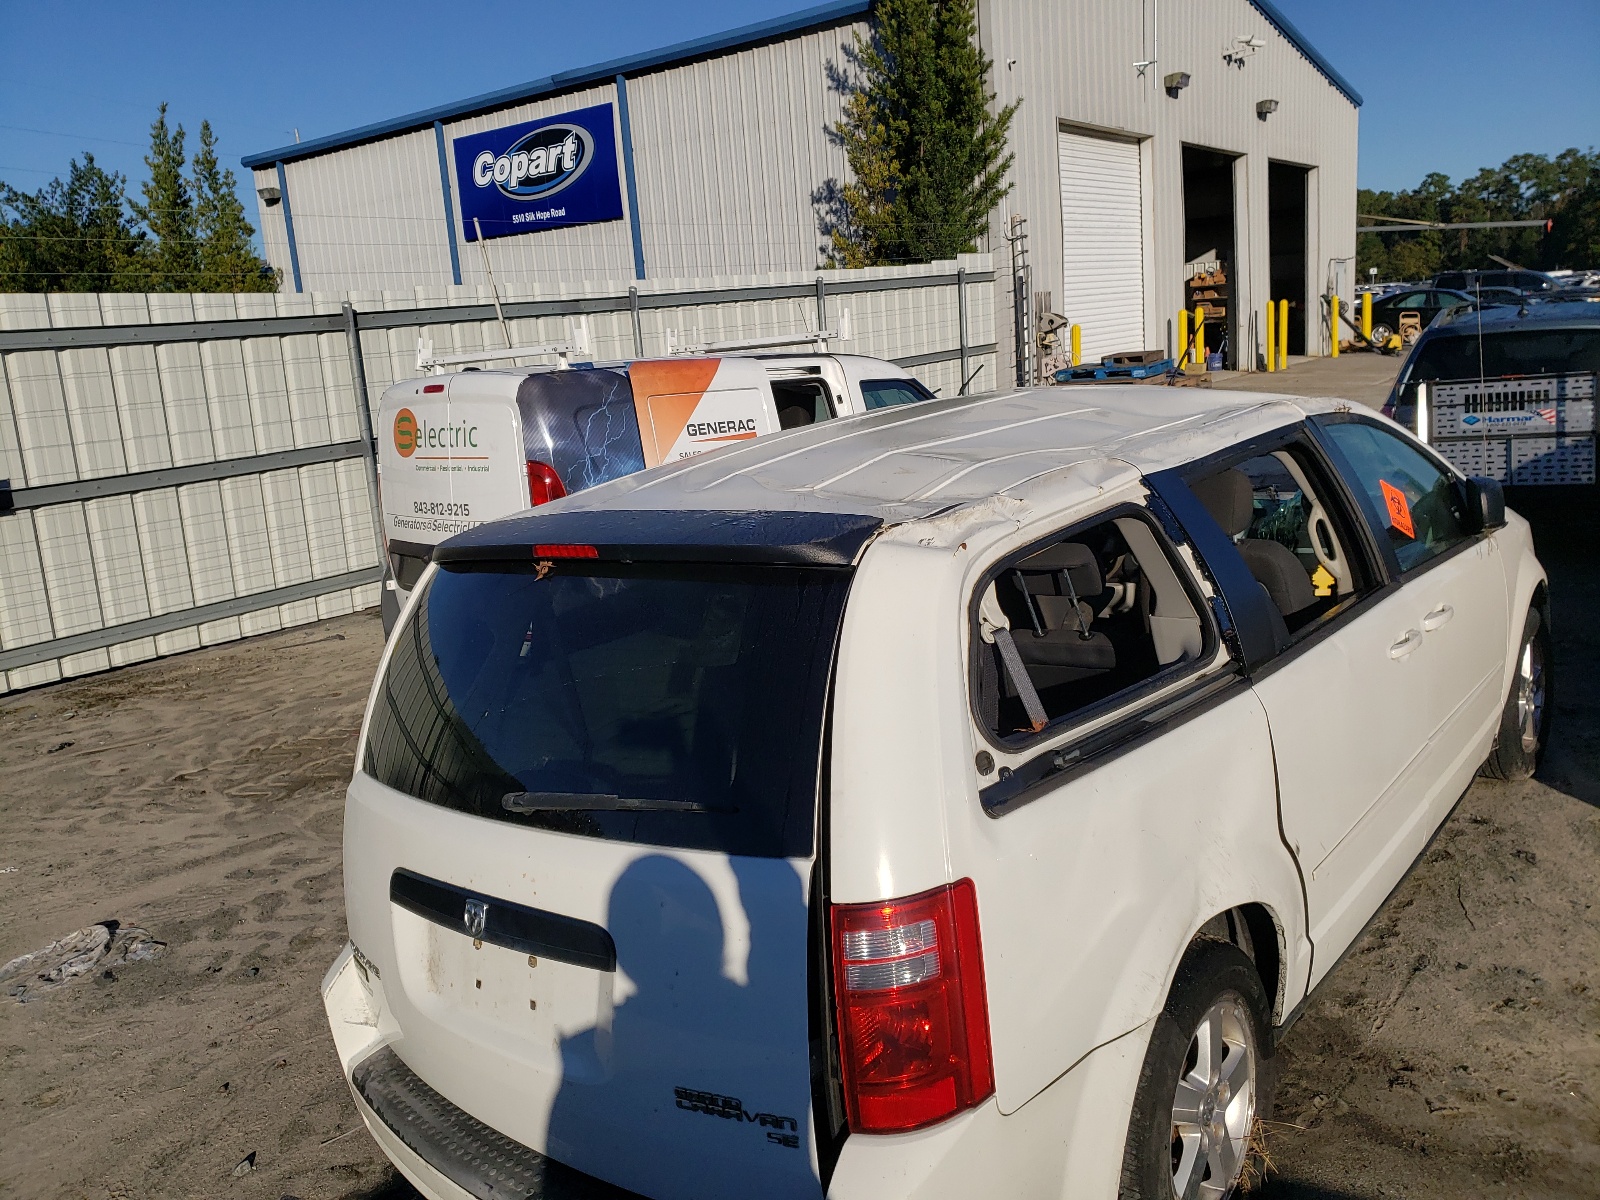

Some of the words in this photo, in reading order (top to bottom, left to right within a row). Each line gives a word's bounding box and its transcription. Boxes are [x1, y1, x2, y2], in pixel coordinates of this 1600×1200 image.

[473, 130, 577, 190] Copart
[512, 214, 525, 224] 5510
[525, 211, 536, 222] Silk
[535, 209, 550, 221] Hope
[550, 207, 566, 217] Road
[686, 418, 756, 437] GENERAC
[1482, 415, 1535, 424] Harmar
[413, 501, 470, 517] 843-812-9215
[675, 1098, 798, 1132] CARAVAN
[766, 1131, 800, 1149] SE
